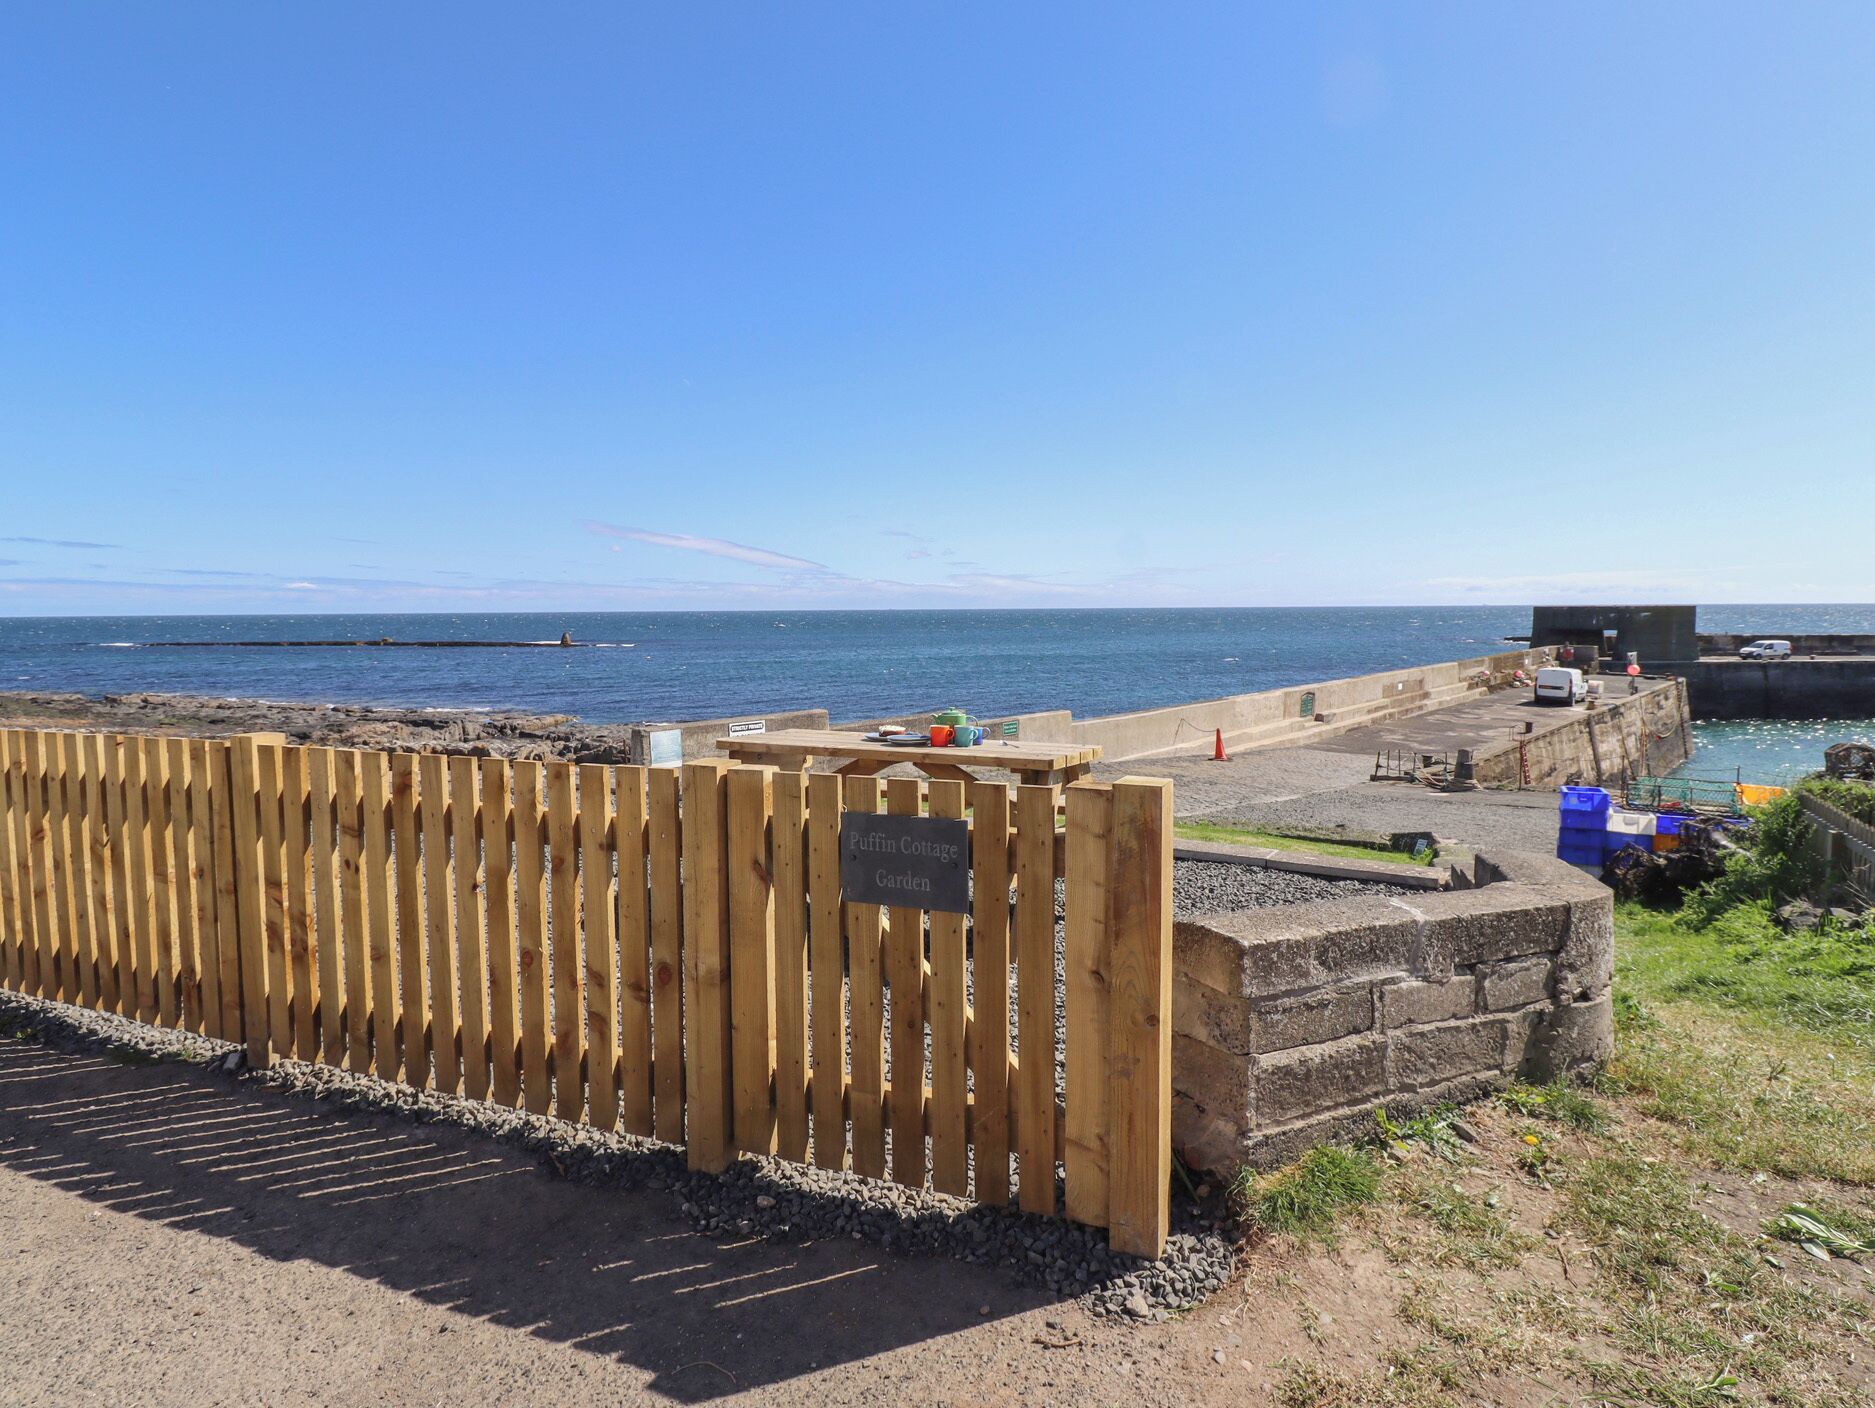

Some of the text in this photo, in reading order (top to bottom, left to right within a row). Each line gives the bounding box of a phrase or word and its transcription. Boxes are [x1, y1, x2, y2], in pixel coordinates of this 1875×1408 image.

[850, 832, 958, 862] Puffin Cottage
[876, 869, 931, 892] Garden
